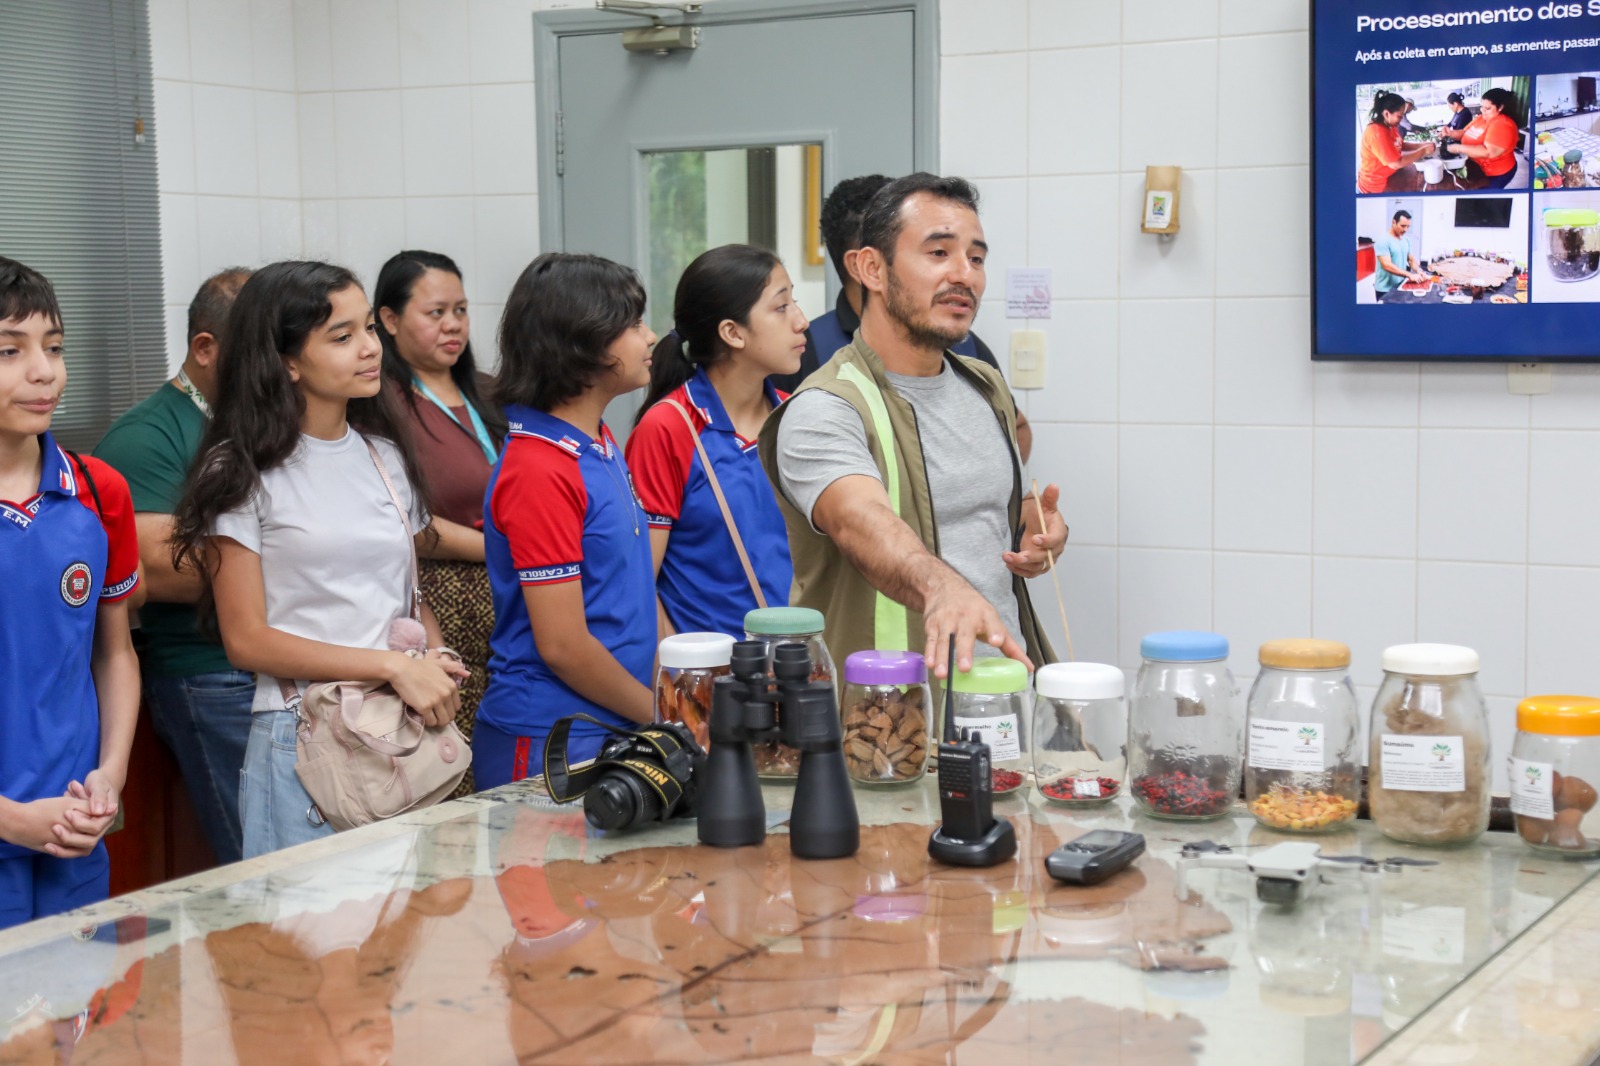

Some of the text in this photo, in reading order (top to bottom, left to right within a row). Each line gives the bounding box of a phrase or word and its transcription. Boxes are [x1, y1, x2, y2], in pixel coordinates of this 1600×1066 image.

[1356, 5, 1533, 32] Processamento
[1537, 2, 1582, 20] das
[1355, 49, 1382, 64] Após
[1383, 51, 1391, 60] a
[1393, 46, 1425, 59] coleta
[1427, 47, 1446, 57] em
[1447, 45, 1489, 60] campo,
[1490, 43, 1503, 53] as
[1505, 39, 1561, 53] sementes
